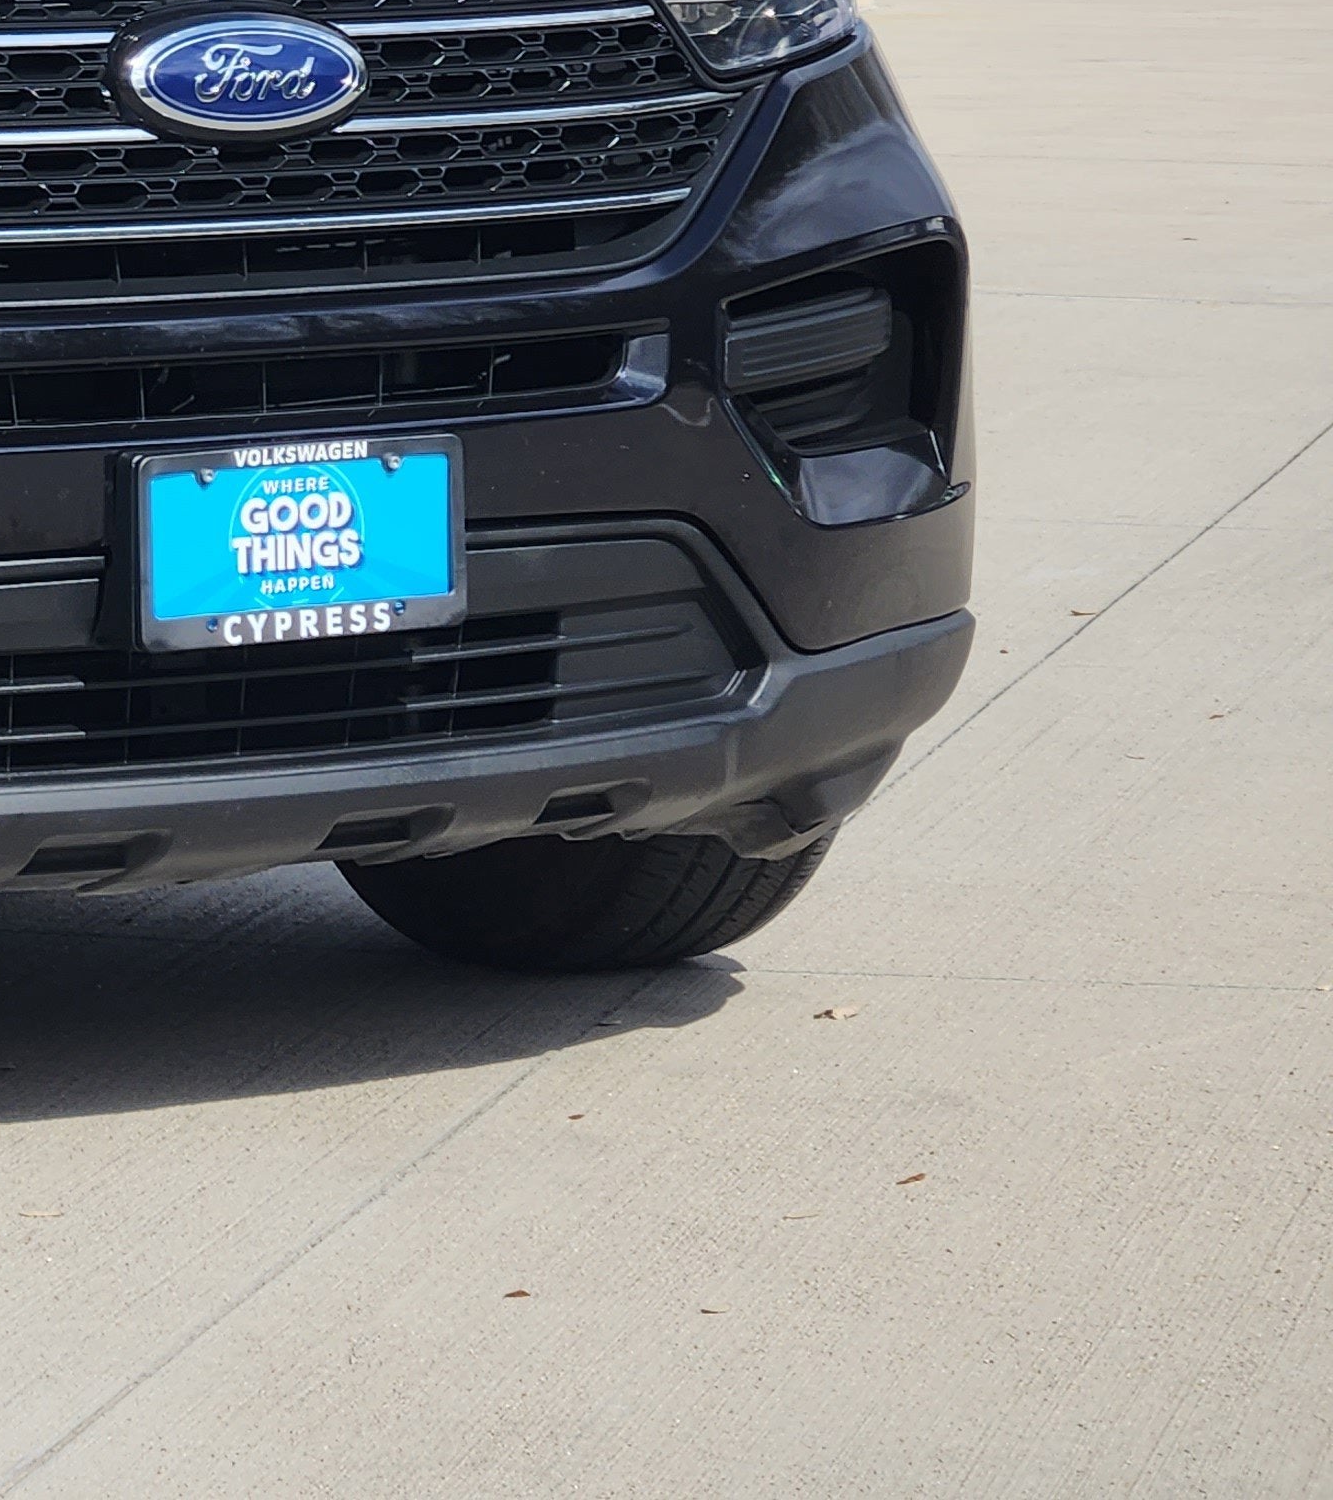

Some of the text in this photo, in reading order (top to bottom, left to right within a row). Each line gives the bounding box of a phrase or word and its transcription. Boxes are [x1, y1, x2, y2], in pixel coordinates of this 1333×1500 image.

[194, 43, 316, 103] Ford
[233, 440, 368, 468] VOLKSWAGEN
[262, 476, 330, 495] WHERE
[239, 491, 352, 535] GOOD
[232, 528, 363, 575] THINGS
[260, 572, 335, 595] HAPPEN
[222, 601, 392, 646] CYPRESS
